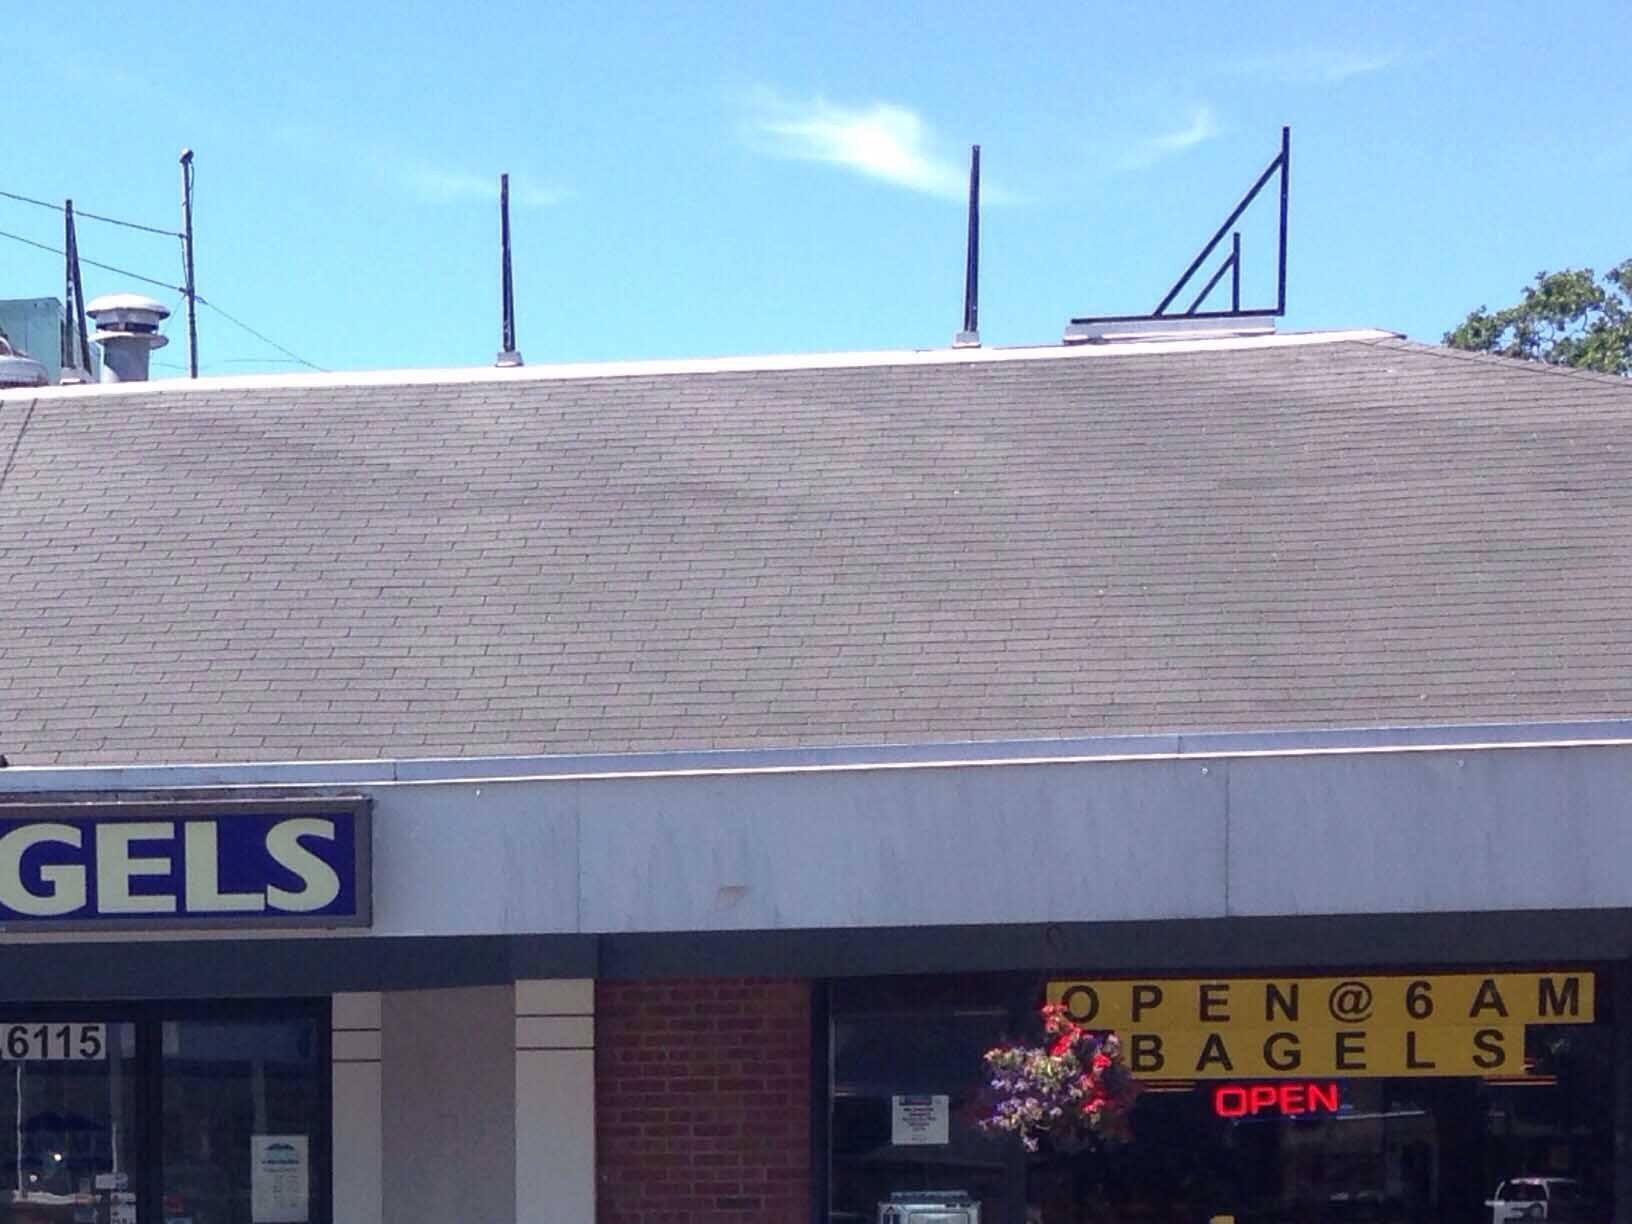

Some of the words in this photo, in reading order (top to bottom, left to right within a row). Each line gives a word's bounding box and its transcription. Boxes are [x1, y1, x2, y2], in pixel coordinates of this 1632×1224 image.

[7, 1024, 102, 1059] 6115
[1130, 1027, 1507, 1073] BAGELS
[1215, 1080, 1339, 1117] OPEN
